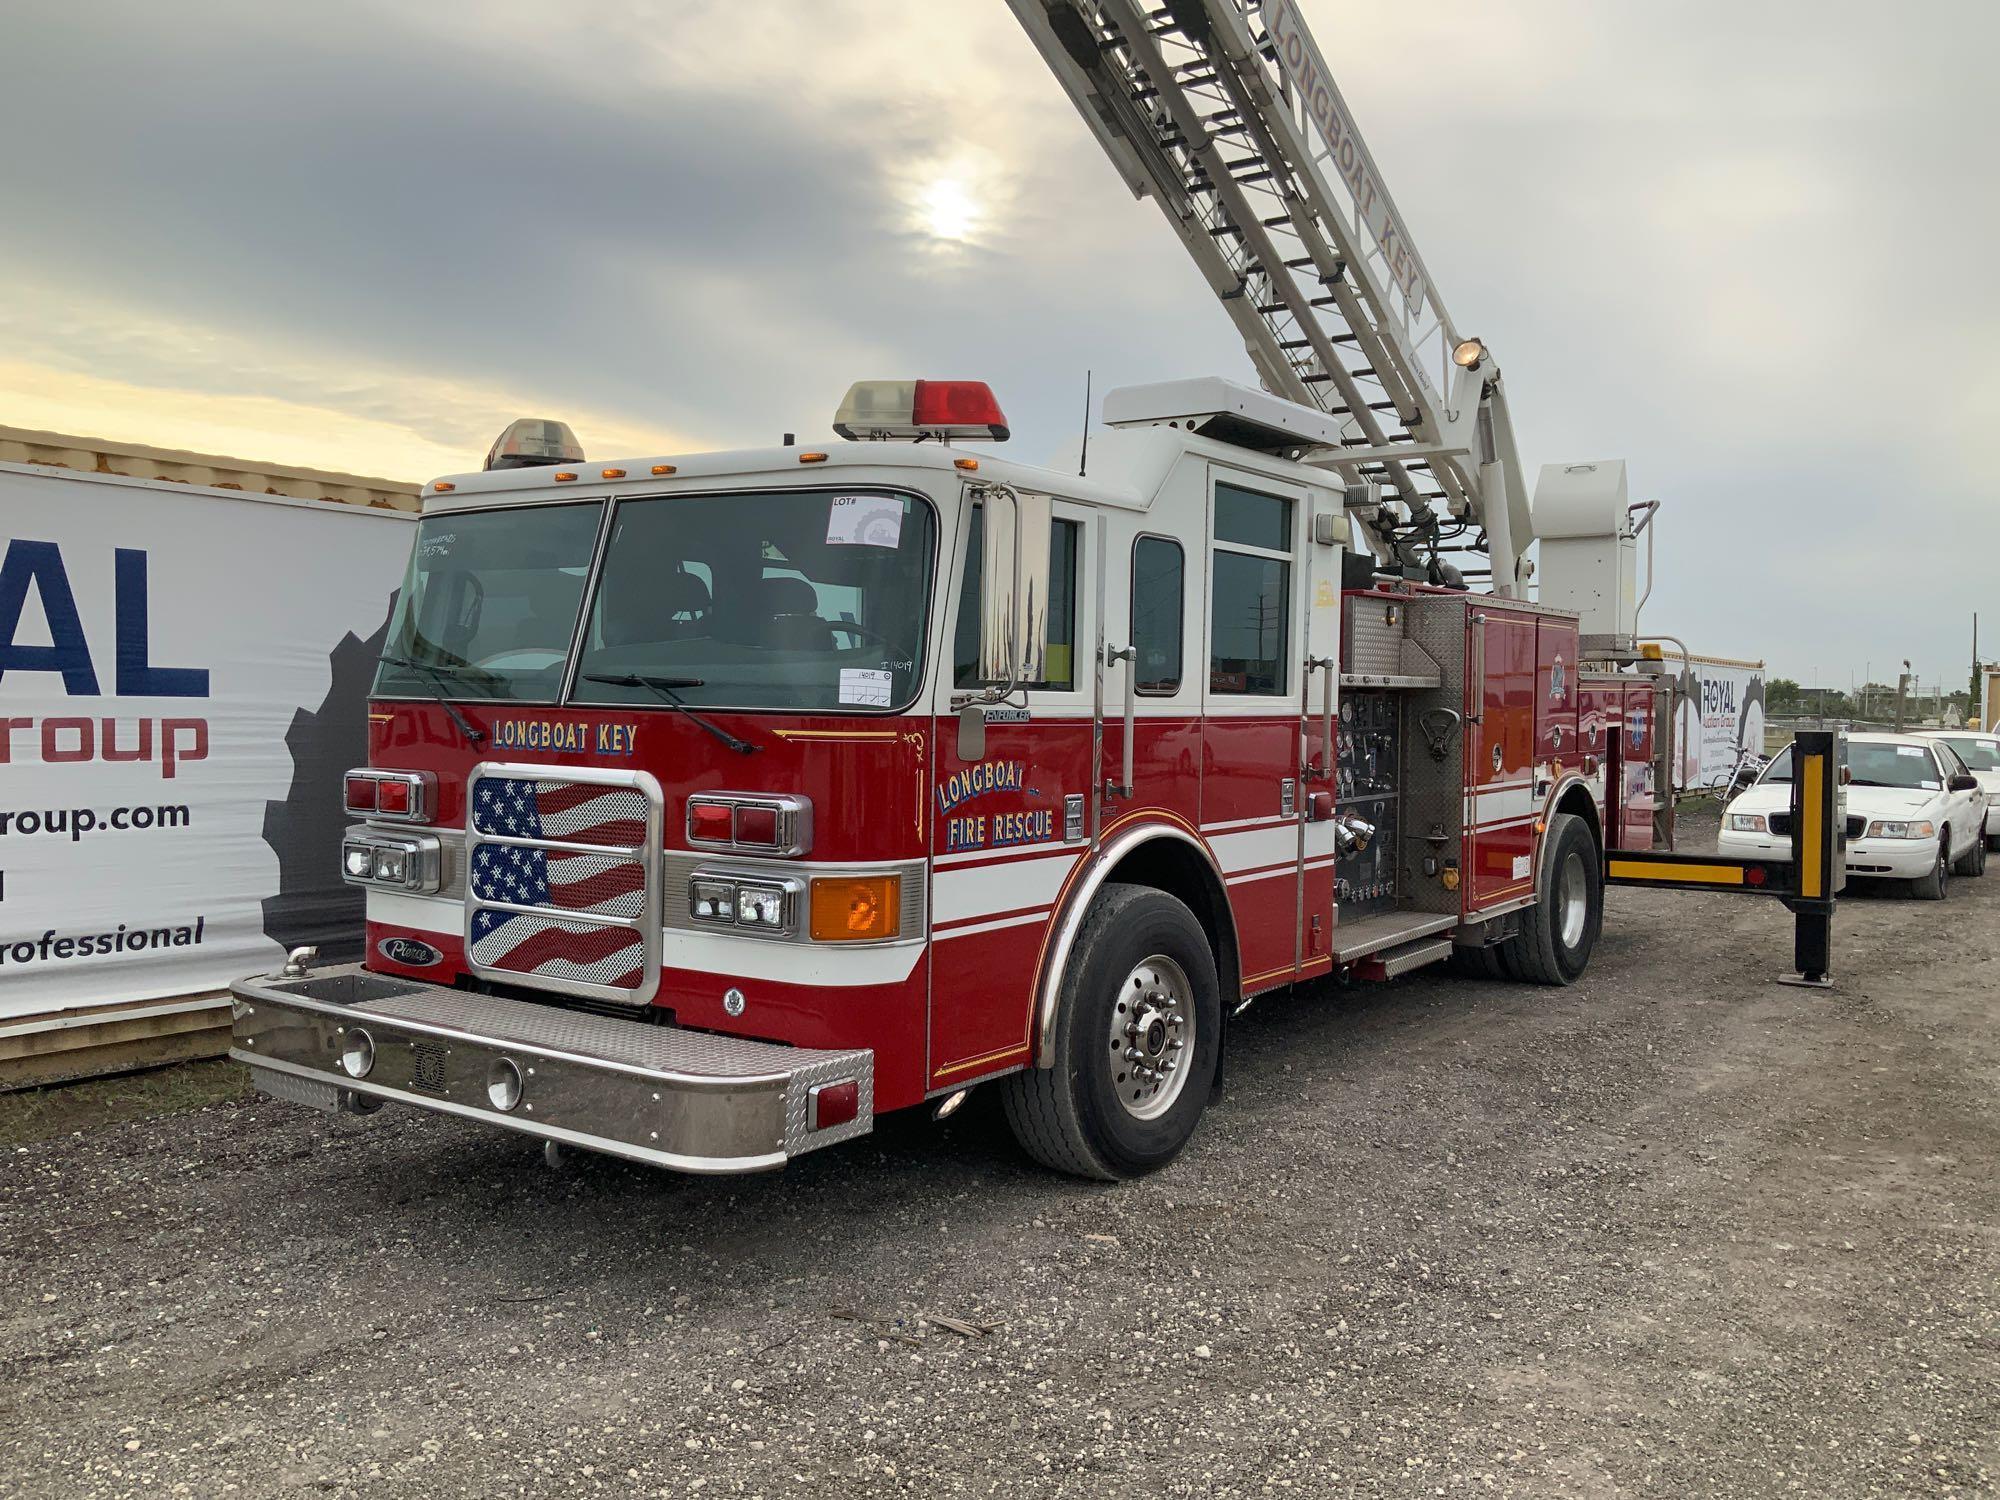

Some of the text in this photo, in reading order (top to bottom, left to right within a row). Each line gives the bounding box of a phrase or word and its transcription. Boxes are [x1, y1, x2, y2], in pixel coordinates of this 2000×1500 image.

[1272, 3, 1418, 297] LONGBOAT KEY
[834, 497, 857, 506] LOT#
[0, 538, 210, 697] AL
[1703, 680, 1736, 713] ROYAL
[985, 710, 1031, 722] ENFORCER
[0, 717, 209, 779] roup
[492, 720, 638, 756] LONGBOAT KEY
[0, 805, 190, 842] roup.com
[947, 810, 1054, 851] FIRE RESCUE
[391, 940, 429, 961] Pierce
